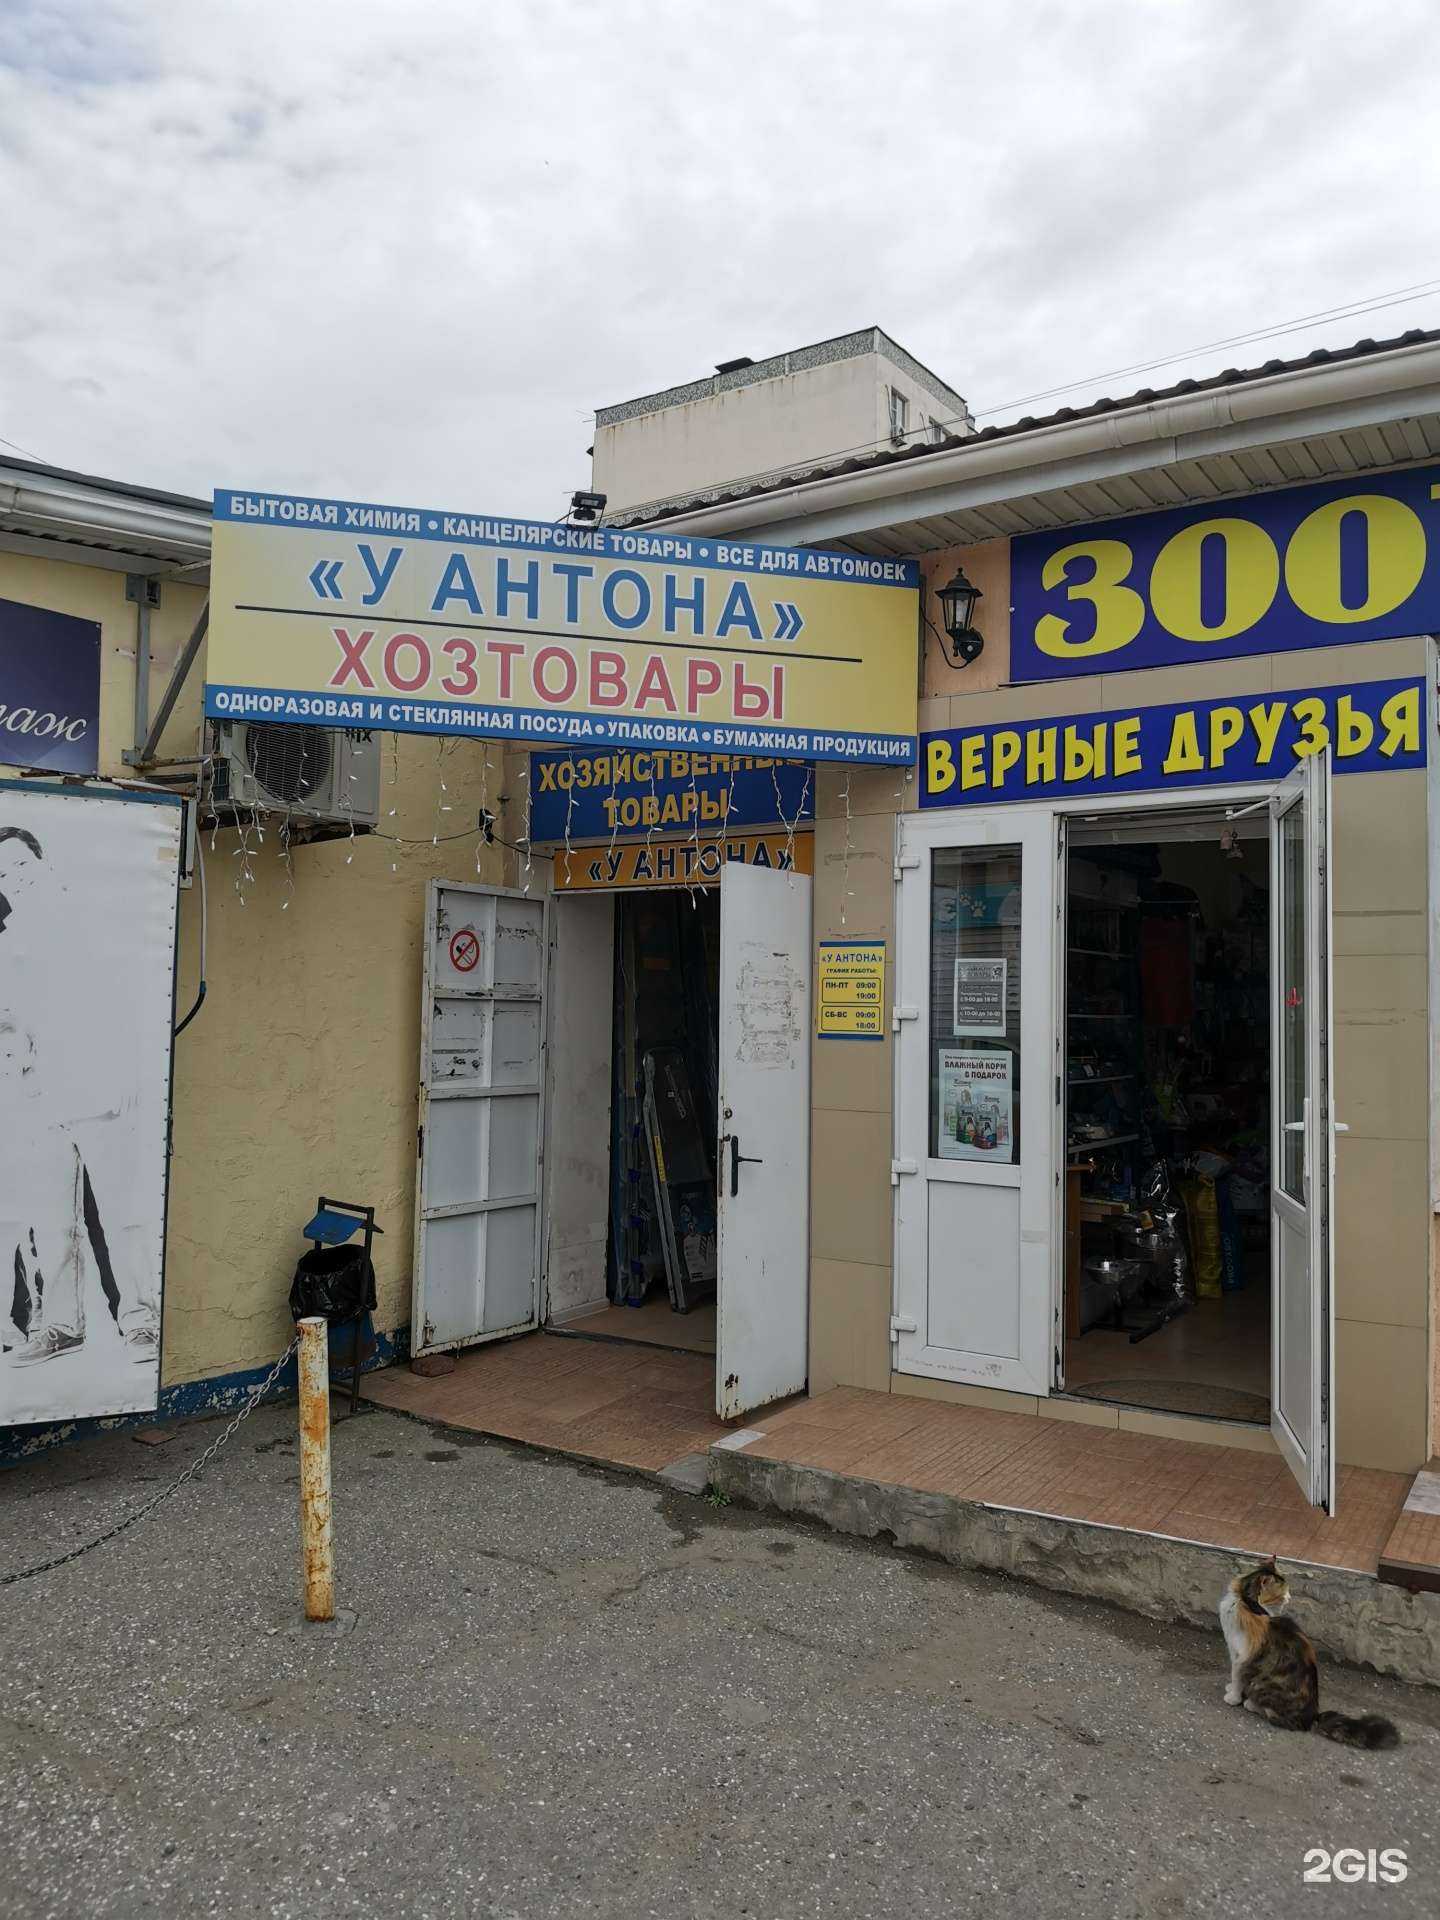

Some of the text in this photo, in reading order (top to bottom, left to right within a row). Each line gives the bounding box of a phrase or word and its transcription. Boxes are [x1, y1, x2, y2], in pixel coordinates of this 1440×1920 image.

[230, 495, 907, 582] БЫТОВАЯ ХИМИЯ КАНЦЕЛЯРСКИЕ ТОВАРЫ ВСЕ ДЛЯ АВТОМОЕК
[308, 543, 805, 641] «У АНТОНА»
[329, 627, 786, 721] ХОЗТОВАРЫ
[215, 692, 912, 758] ОДНОРАЗОВАЯ И СТЕКЛЯННАЯ ПОСУДА УПАКОВКА БУМАЖНАЯ ПРОДУКЦИЯ
[926, 686, 1421, 796] ВЕРНЫЕ ДРУЗЬЯ
[602, 789, 728, 828] ТОВАРЫ
[587, 849, 625, 882] «У
[835, 952, 883, 963] АНТОНА»
[944, 1060, 1007, 1070] ВЛАЖНЫЙ КОРМ
[971, 1071, 1007, 1080] ПОДАРОК
